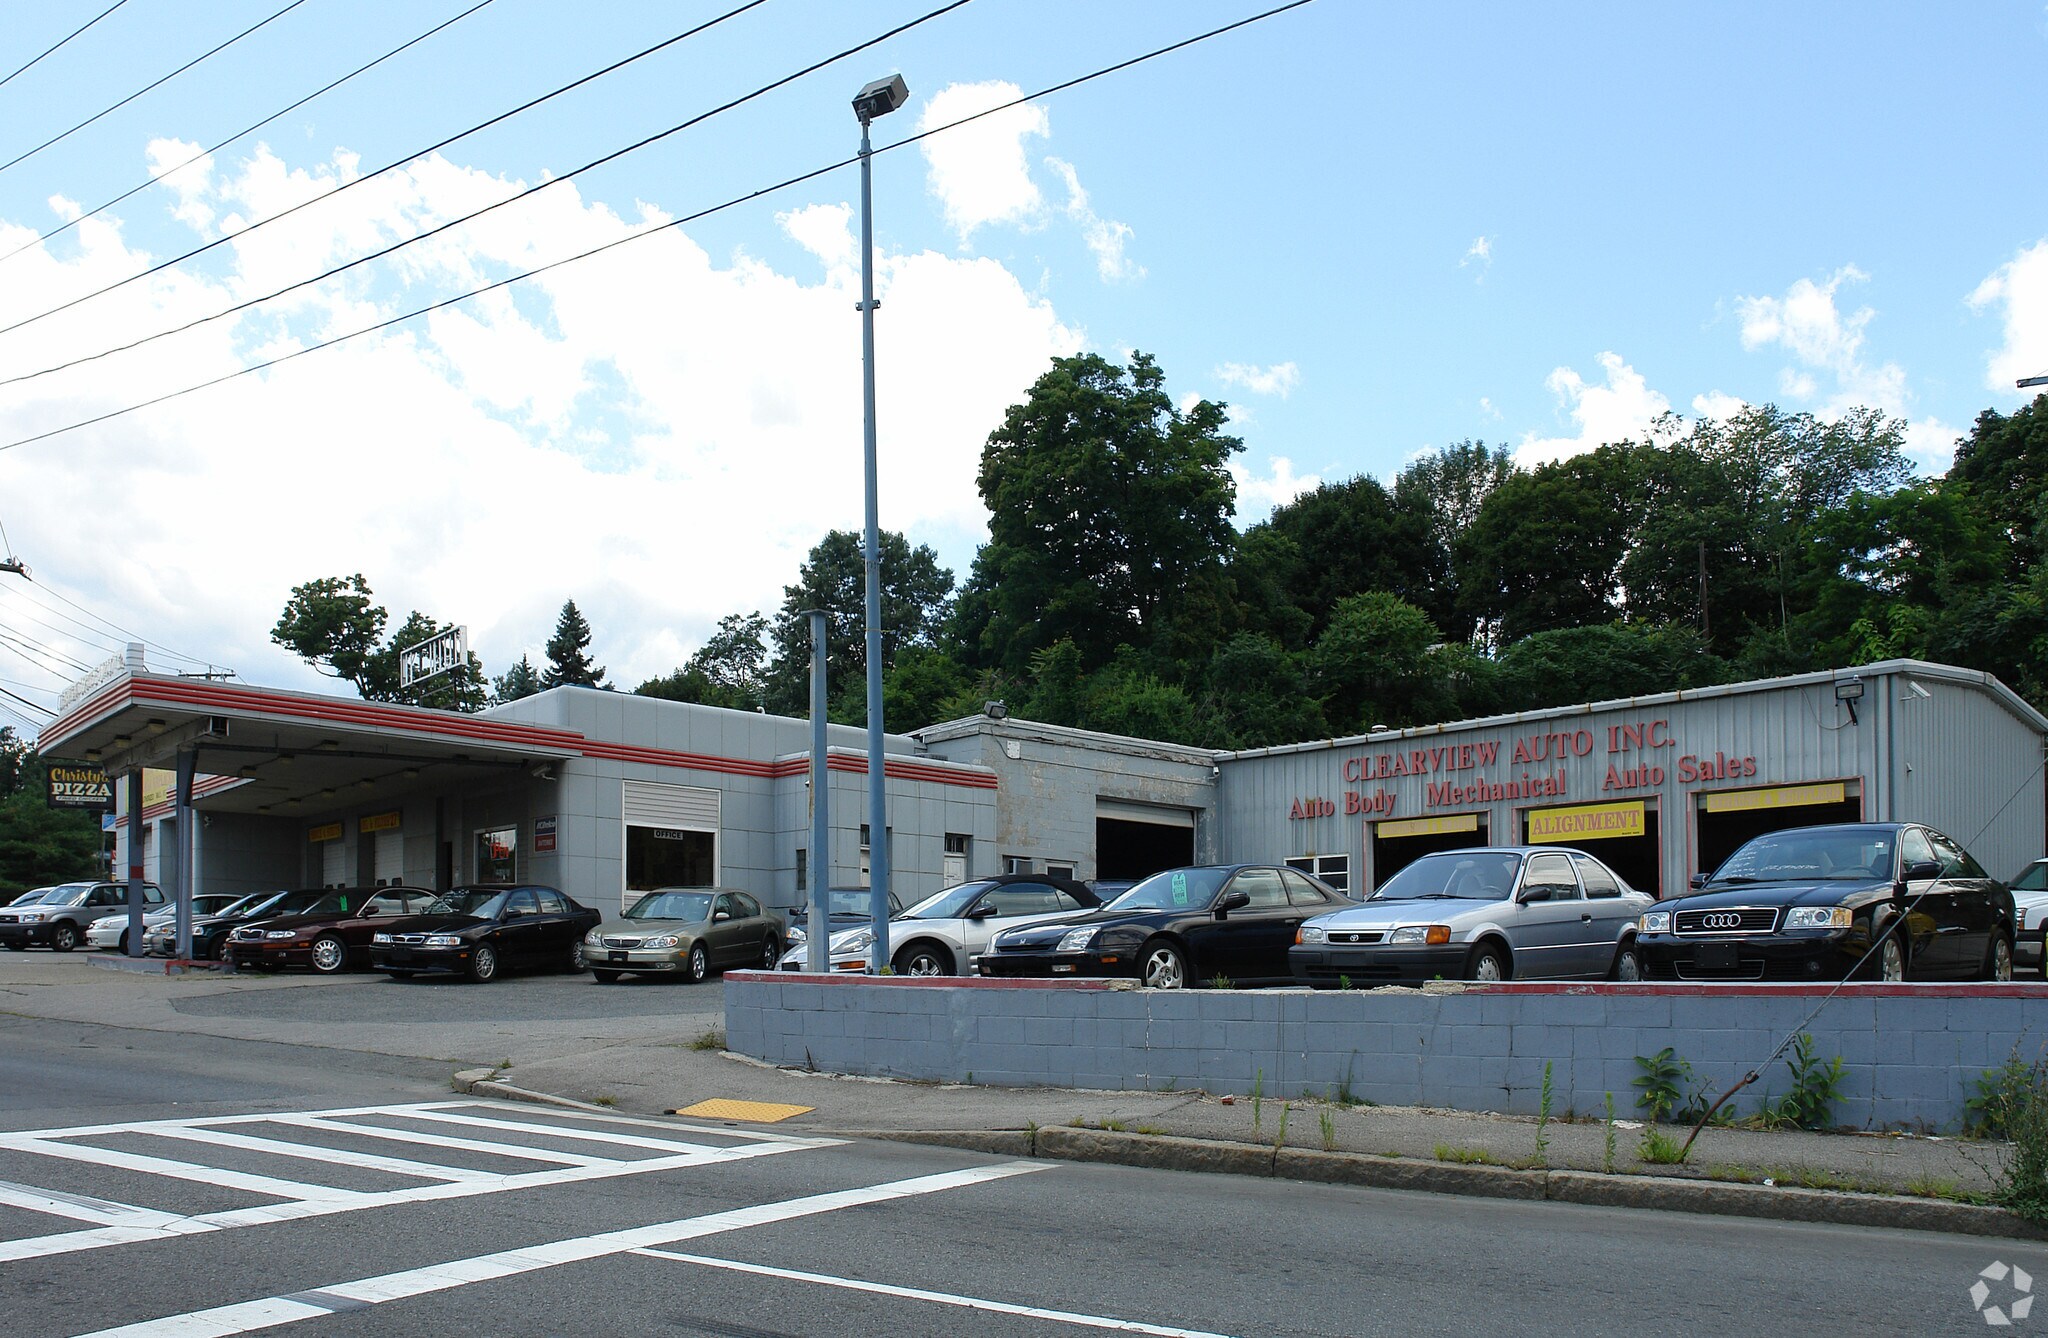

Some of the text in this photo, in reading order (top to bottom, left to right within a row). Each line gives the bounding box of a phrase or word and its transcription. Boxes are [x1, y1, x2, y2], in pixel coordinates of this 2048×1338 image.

[1343, 720, 1676, 782] CLEARVIEW AUTO INC.
[51, 782, 112, 796] PIZZA
[1289, 752, 1757, 820] Auto Body Mechanical Auto Sales
[655, 830, 682, 839] OFFICE
[1532, 810, 1640, 836] ALIGNMENT
